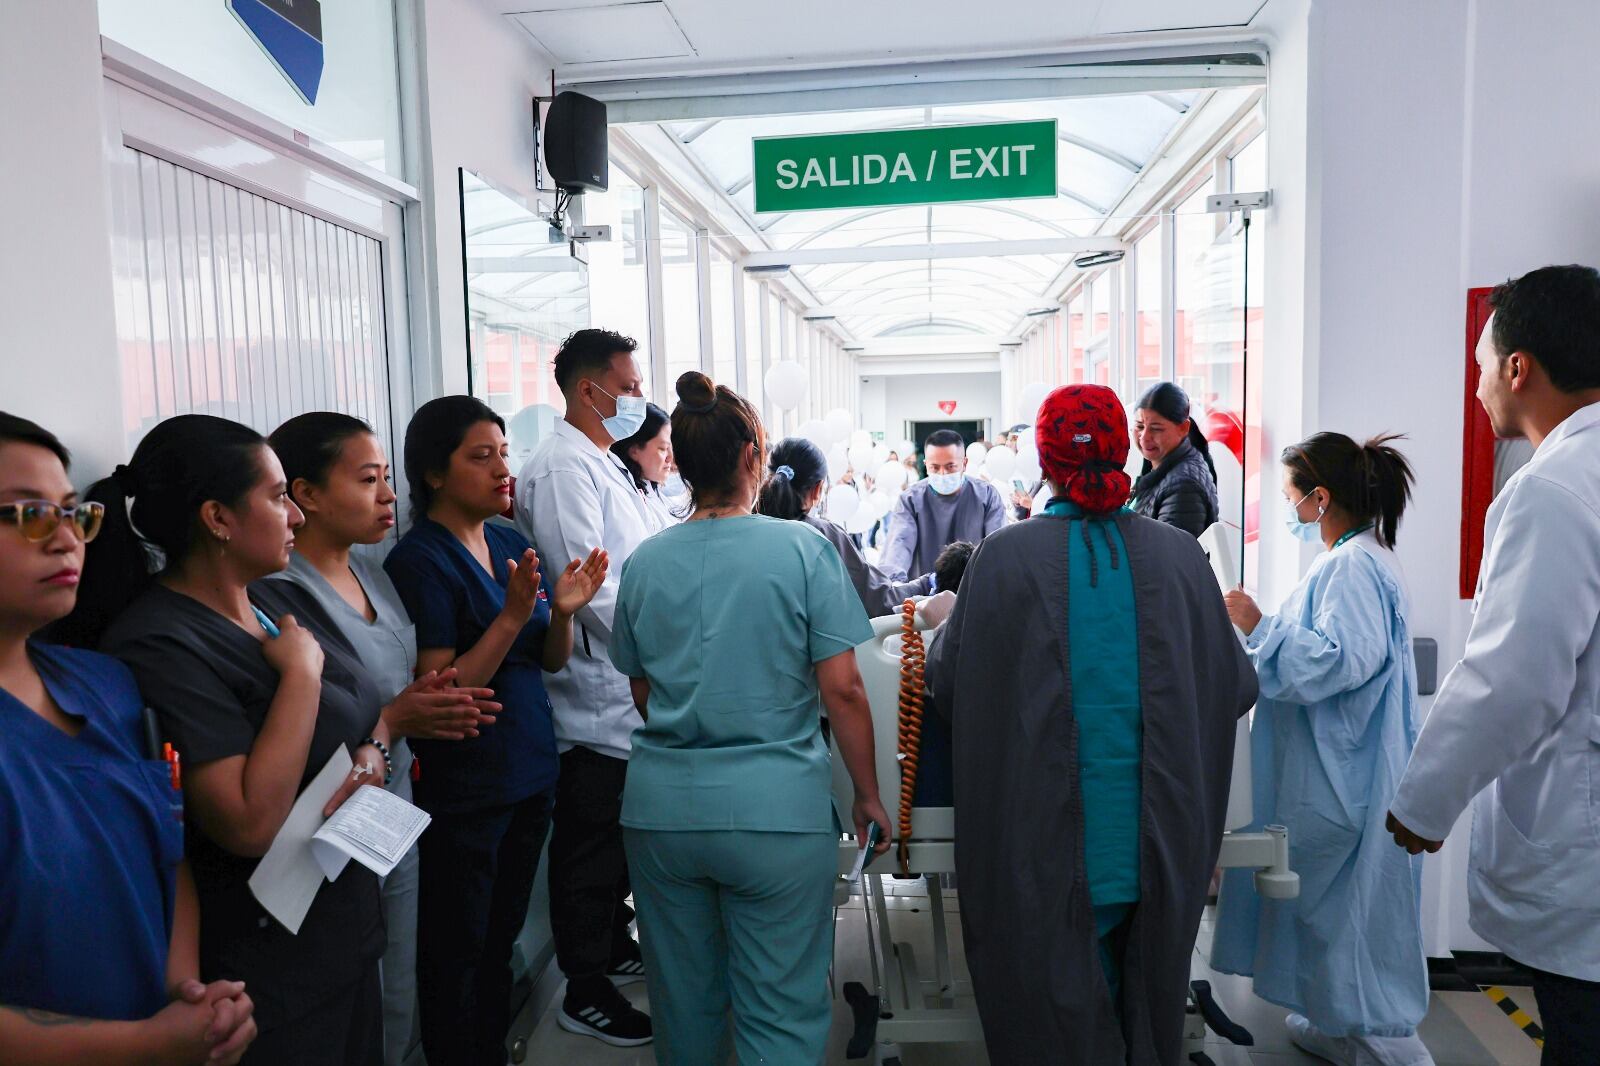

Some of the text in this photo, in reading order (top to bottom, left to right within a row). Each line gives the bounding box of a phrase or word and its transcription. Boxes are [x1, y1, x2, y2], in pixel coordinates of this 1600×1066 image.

[776, 144, 1035, 190] SALIDA / EXIT
